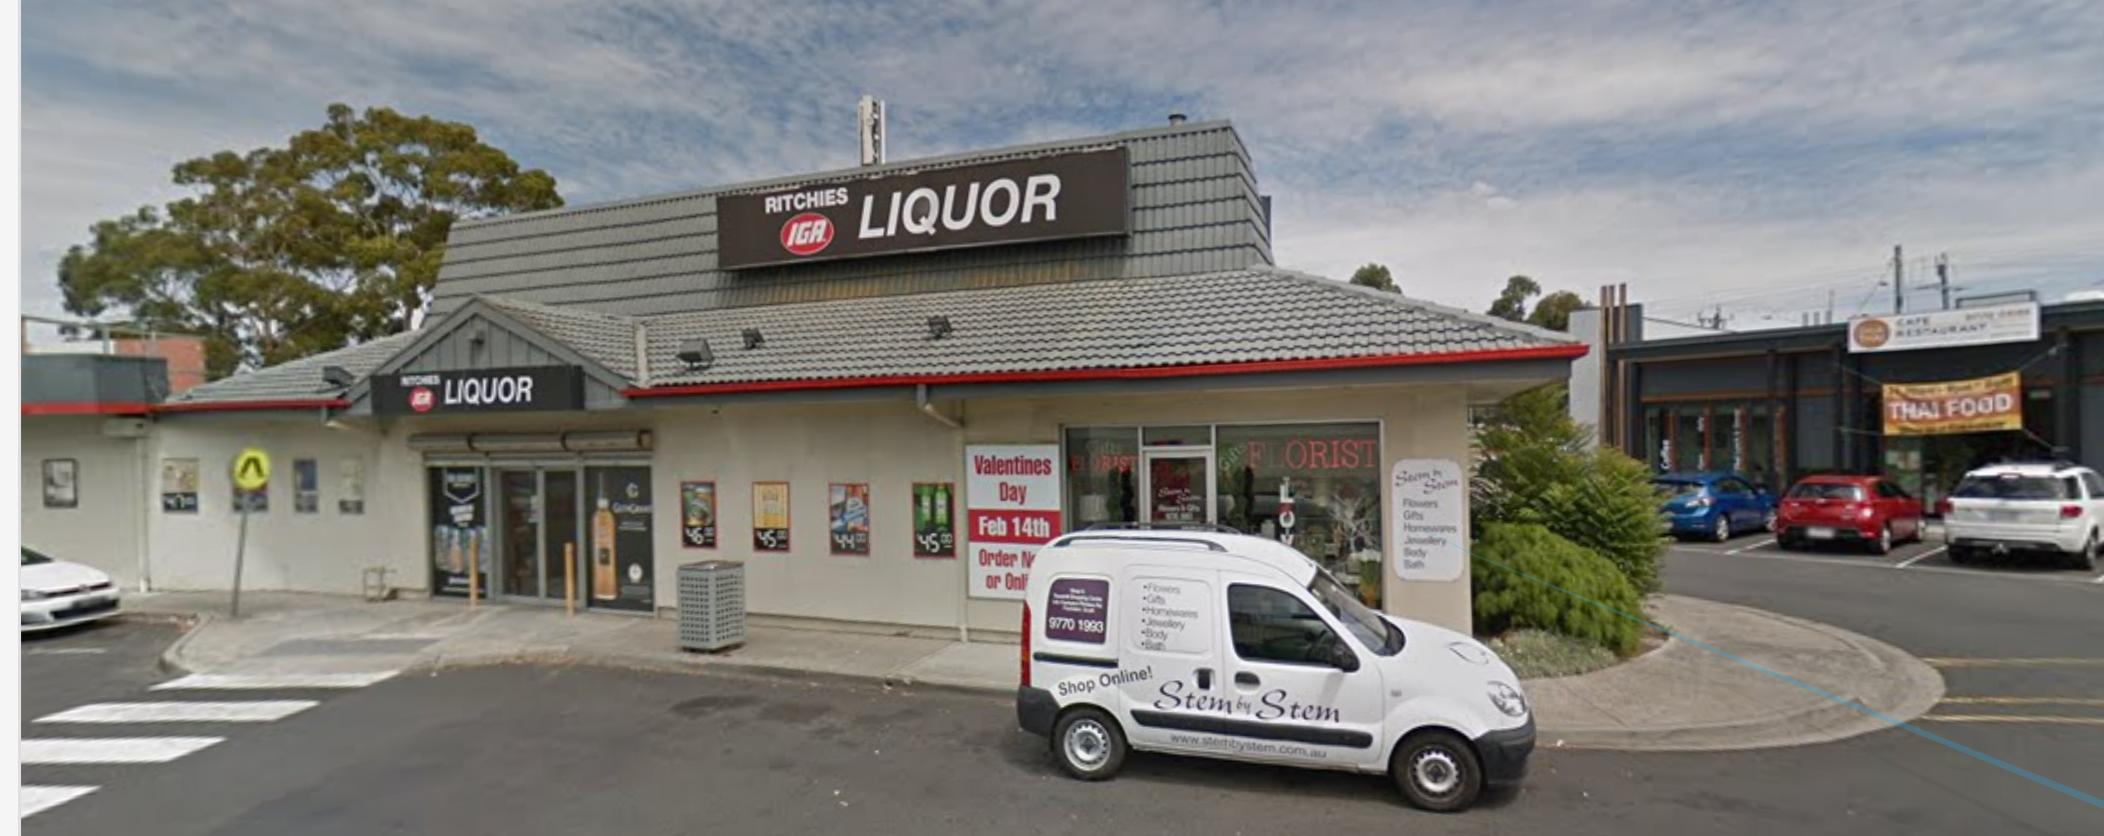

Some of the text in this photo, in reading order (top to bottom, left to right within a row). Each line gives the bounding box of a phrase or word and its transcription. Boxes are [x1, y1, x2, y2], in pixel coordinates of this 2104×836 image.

[764, 186, 849, 214] RITCHIES
[858, 173, 1062, 238] LIQUOR
[787, 218, 827, 247] IGA
[444, 376, 534, 406] LIQUOR
[1889, 393, 2013, 421] THAI FOOD
[1246, 438, 1377, 469] FLORIST
[974, 455, 1052, 476] Valentines
[1395, 470, 1430, 487] Stem
[1422, 478, 1459, 494] Stem
[999, 482, 1027, 505] Day
[1403, 498, 1438, 508] Flowers
[1403, 510, 1424, 520] Gifts
[978, 515, 1050, 538] Feb 14th
[1403, 522, 1457, 533] Homewares
[757, 529, 777, 548] 45
[833, 533, 855, 549] 44
[917, 533, 940, 552] 45
[978, 548, 1018, 568] Order
[986, 572, 1028, 590] or Onli
[1049, 616, 1104, 634] 9770 1993
[1058, 665, 1153, 696] Shop Online!
[1153, 680, 1340, 723] Stem by Stem
[1170, 734, 1327, 758] www.stembystem.com.au
